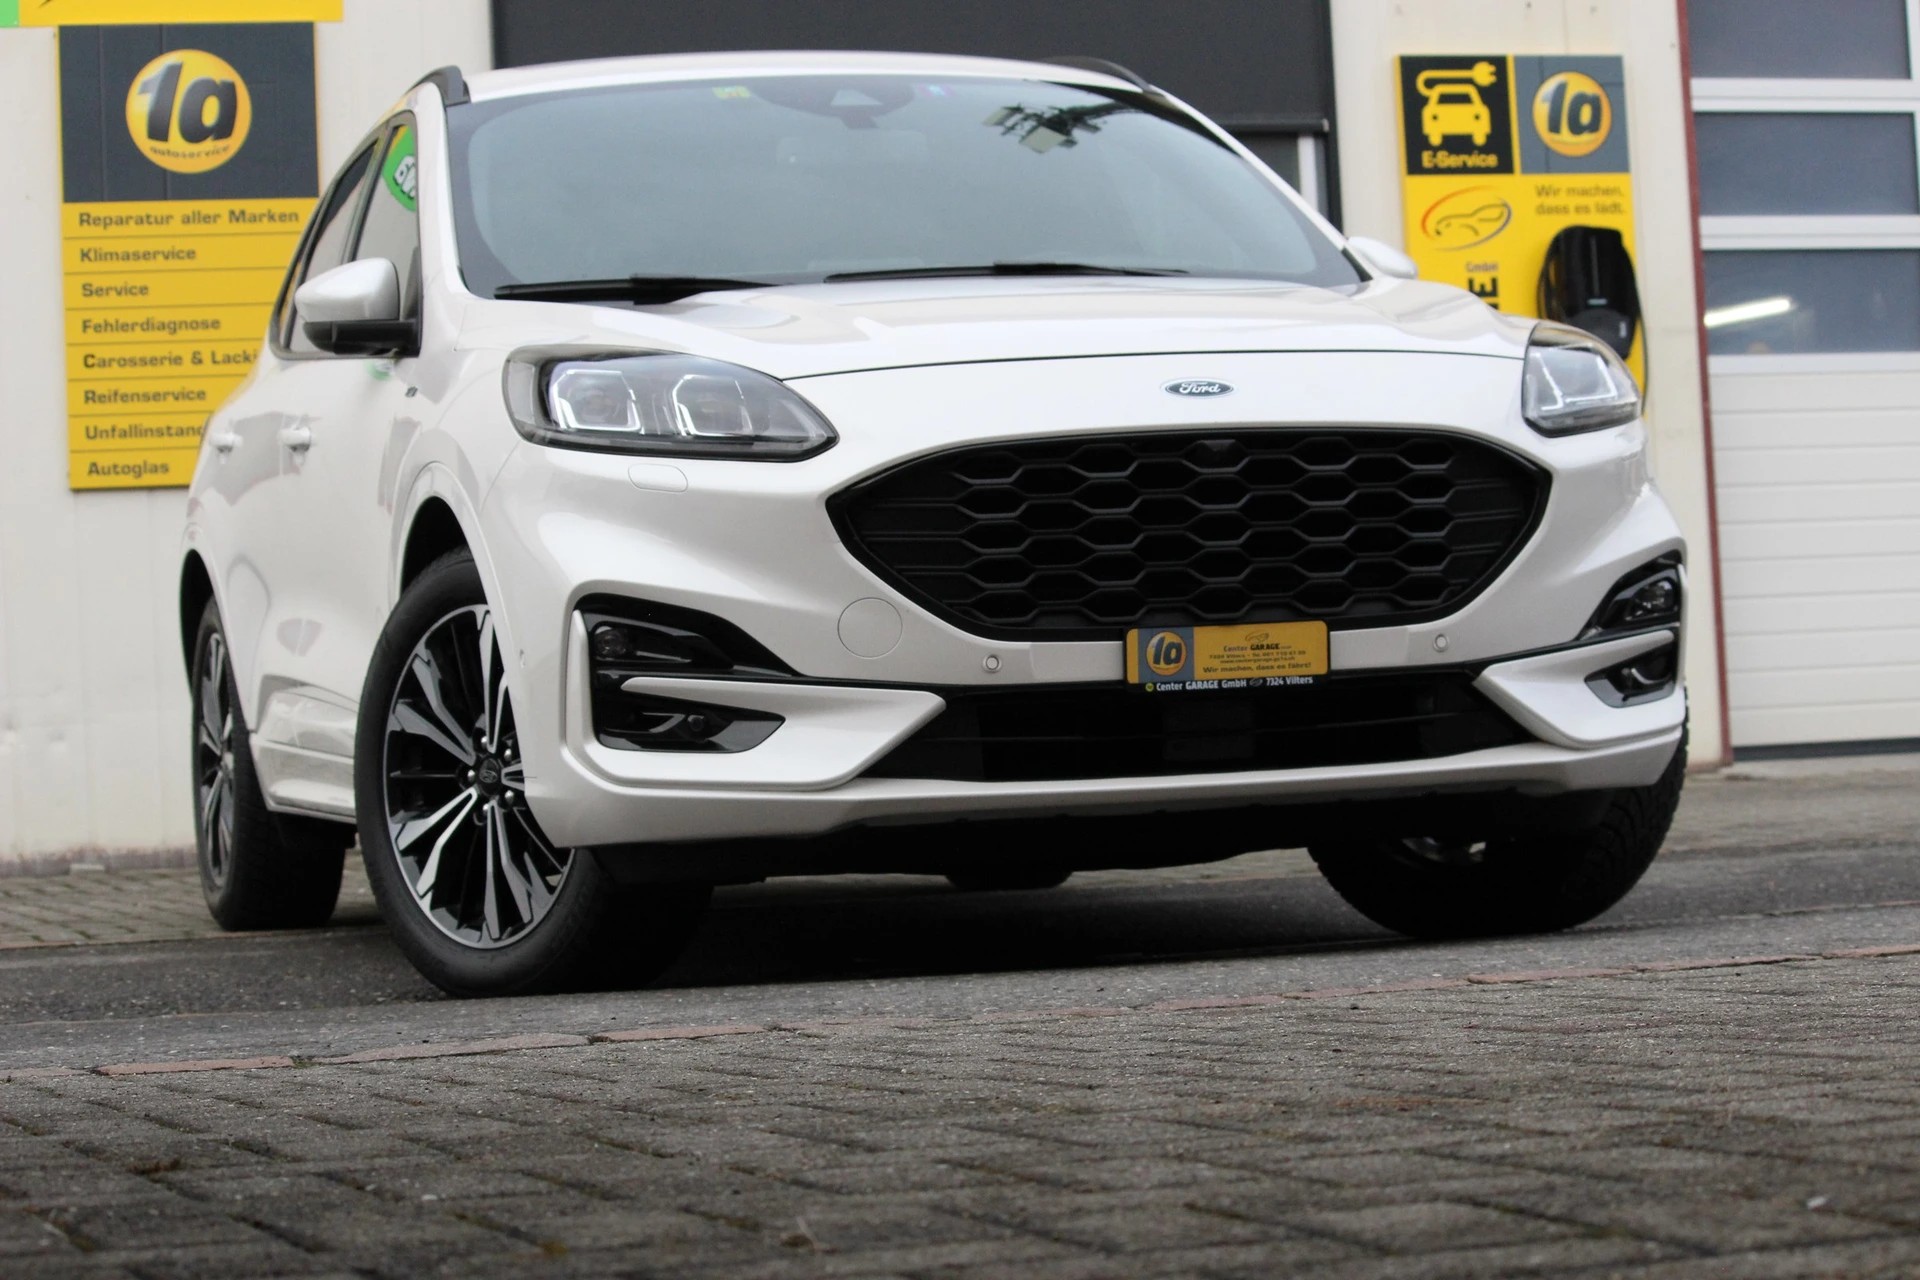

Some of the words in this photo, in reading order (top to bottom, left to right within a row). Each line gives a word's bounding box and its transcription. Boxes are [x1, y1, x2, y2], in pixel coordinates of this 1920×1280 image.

[138, 62, 237, 144] 1a
[1543, 80, 1602, 136] 1a
[1421, 150, 1498, 168] E-Service
[79, 212, 173, 230] Reparatur
[181, 210, 221, 225] aller
[228, 209, 299, 224] Marken
[80, 247, 196, 262] Klimaservice
[81, 281, 149, 297] Service
[82, 317, 221, 335] Fehlerdiagnose
[83, 352, 182, 369] Carosserie
[190, 351, 204, 365] &
[84, 387, 206, 404] Reifenservice
[1179, 381, 1221, 394] Ford
[88, 460, 169, 479] Autoglas
[1223, 645, 1248, 653] Center
[1250, 643, 1280, 651] GARAGE
[1156, 682, 1183, 691] Center
[1185, 680, 1219, 690] GARAGE
[1221, 679, 1247, 689] GmbH
[1286, 676, 1313, 685] Vilters
